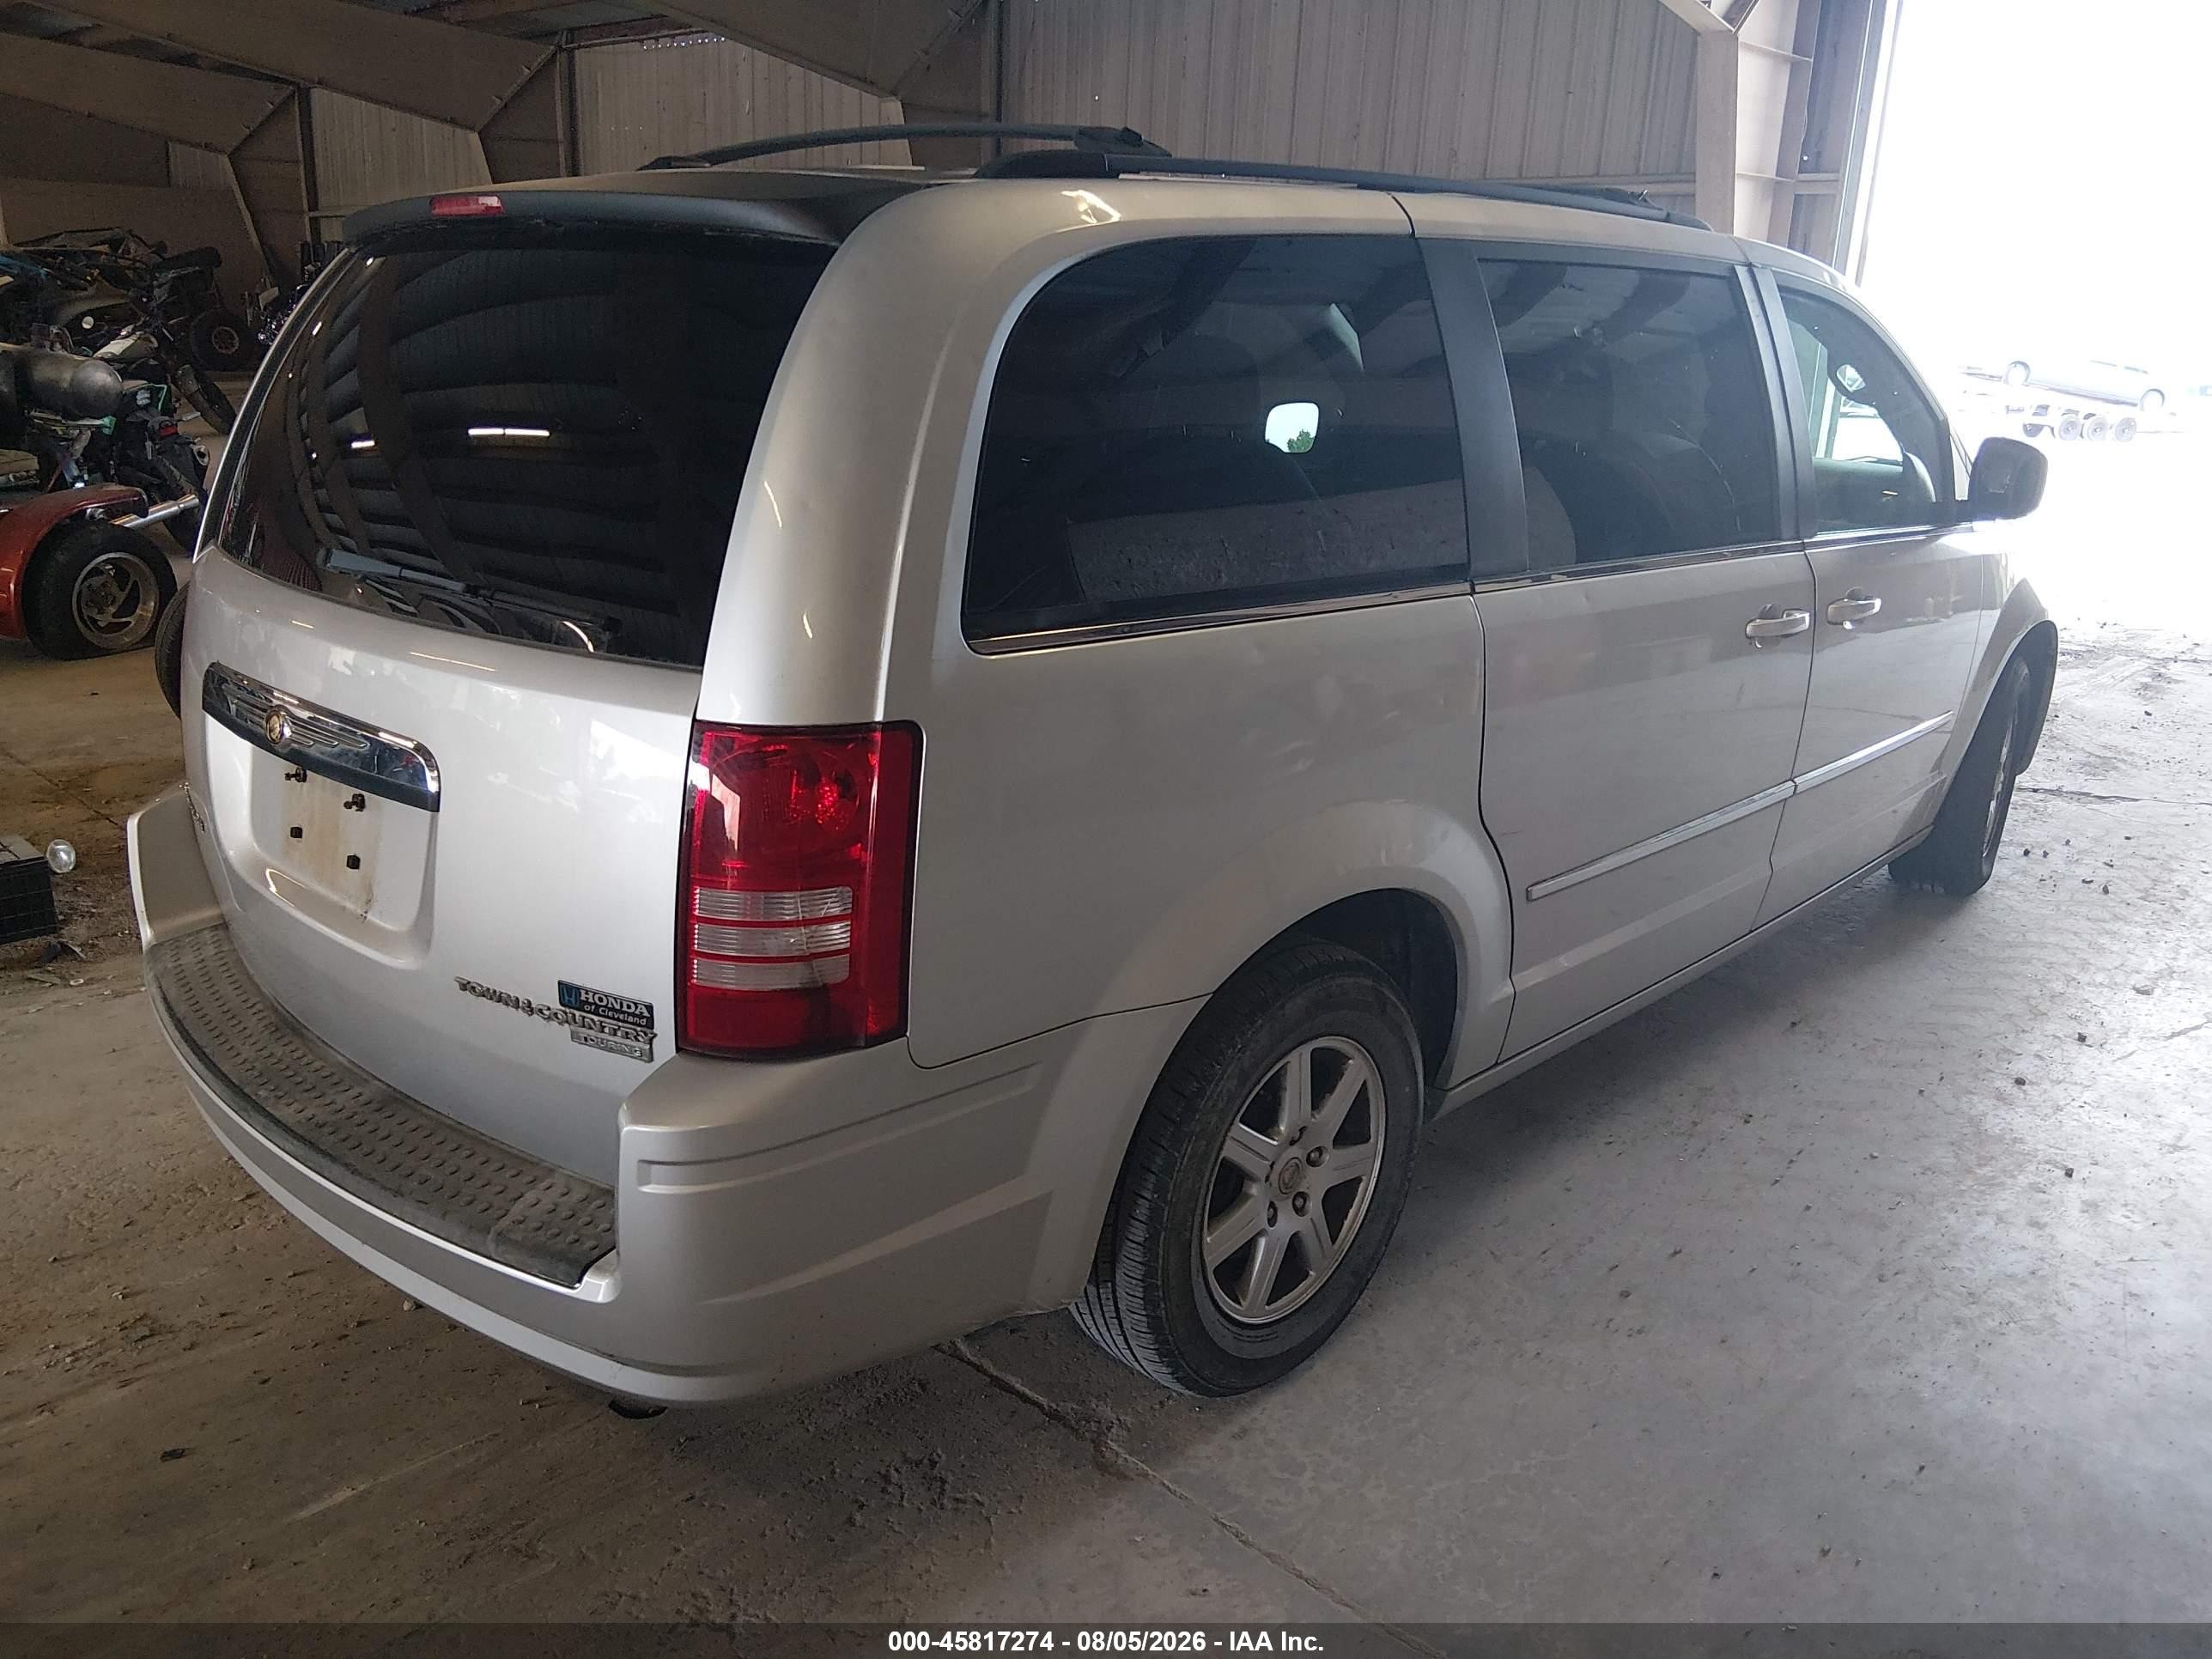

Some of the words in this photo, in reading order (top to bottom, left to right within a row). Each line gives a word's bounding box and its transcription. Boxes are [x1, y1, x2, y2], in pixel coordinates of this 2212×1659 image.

[580, 988, 650, 1018] HONDA
[584, 1004, 597, 1013] of
[599, 1007, 647, 1026] Cleveland
[580, 1035, 643, 1057] TOURING
